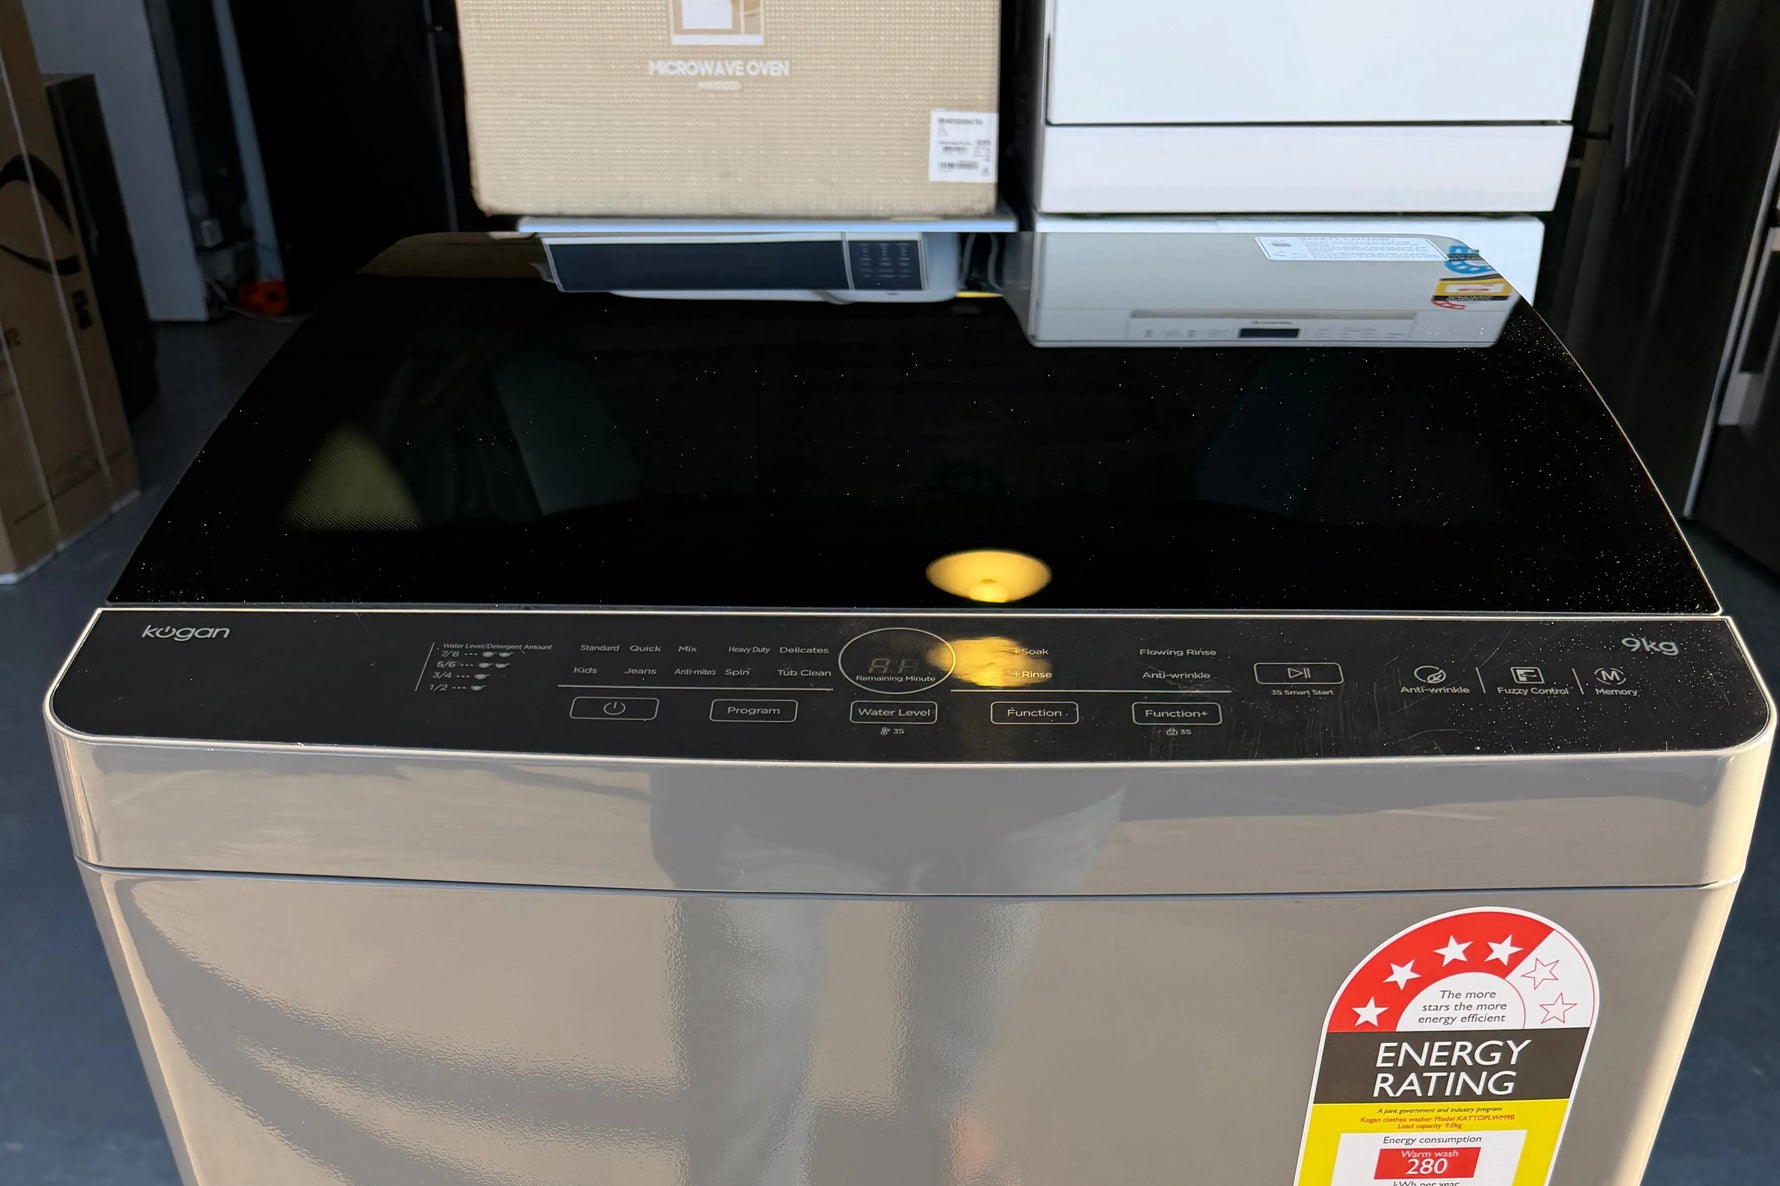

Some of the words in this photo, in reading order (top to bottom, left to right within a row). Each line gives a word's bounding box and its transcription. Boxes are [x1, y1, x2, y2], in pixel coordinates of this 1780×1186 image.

[649, 60, 745, 77] MICROWAVE
[746, 60, 790, 77] OVEN
[142, 624, 230, 642] kogan
[581, 644, 620, 652] Standard
[629, 645, 662, 653] Quick
[678, 645, 697, 653] Mix
[728, 646, 750, 654] Heavy
[752, 646, 770, 654] Duty
[779, 646, 829, 654] Delicates
[1621, 637, 1679, 656] 9kg
[1139, 649, 1183, 657] Flowing
[1186, 648, 1216, 656] Rinse
[432, 672, 452, 680] 3/4
[674, 668, 716, 676] Anti-mites
[725, 669, 749, 677] Spin
[801, 669, 831, 677] Clean
[1142, 671, 1210, 679] Anti-wrinkle
[856, 675, 902, 683] Remaining
[430, 684, 448, 692] 1/2
[1400, 686, 1470, 694] Anti-wrinkle
[1497, 687, 1528, 696] Fuzzy
[1530, 687, 1568, 695] Control
[1595, 688, 1638, 696] Memory
[727, 706, 781, 716] Program
[858, 708, 896, 717] Water
[899, 708, 930, 717] Level
[1007, 708, 1062, 717] Function
[1145, 709, 1208, 718] Function+
[1440, 990, 1462, 999] The
[1465, 991, 1496, 999] more
[1422, 1003, 1450, 1012] stars
[1454, 1002, 1472, 1011] the
[1476, 1003, 1507, 1011] more
[1418, 1015, 1457, 1025] energy
[1461, 1013, 1506, 1023] efficient
[1375, 1039, 1532, 1068] ENERGY
[1372, 1071, 1517, 1098] RATING
[1383, 1136, 1416, 1145] Energy
[1419, 1135, 1482, 1145] consumption
[1401, 1150, 1432, 1158] Warm
[1405, 1159, 1448, 1175] 280
